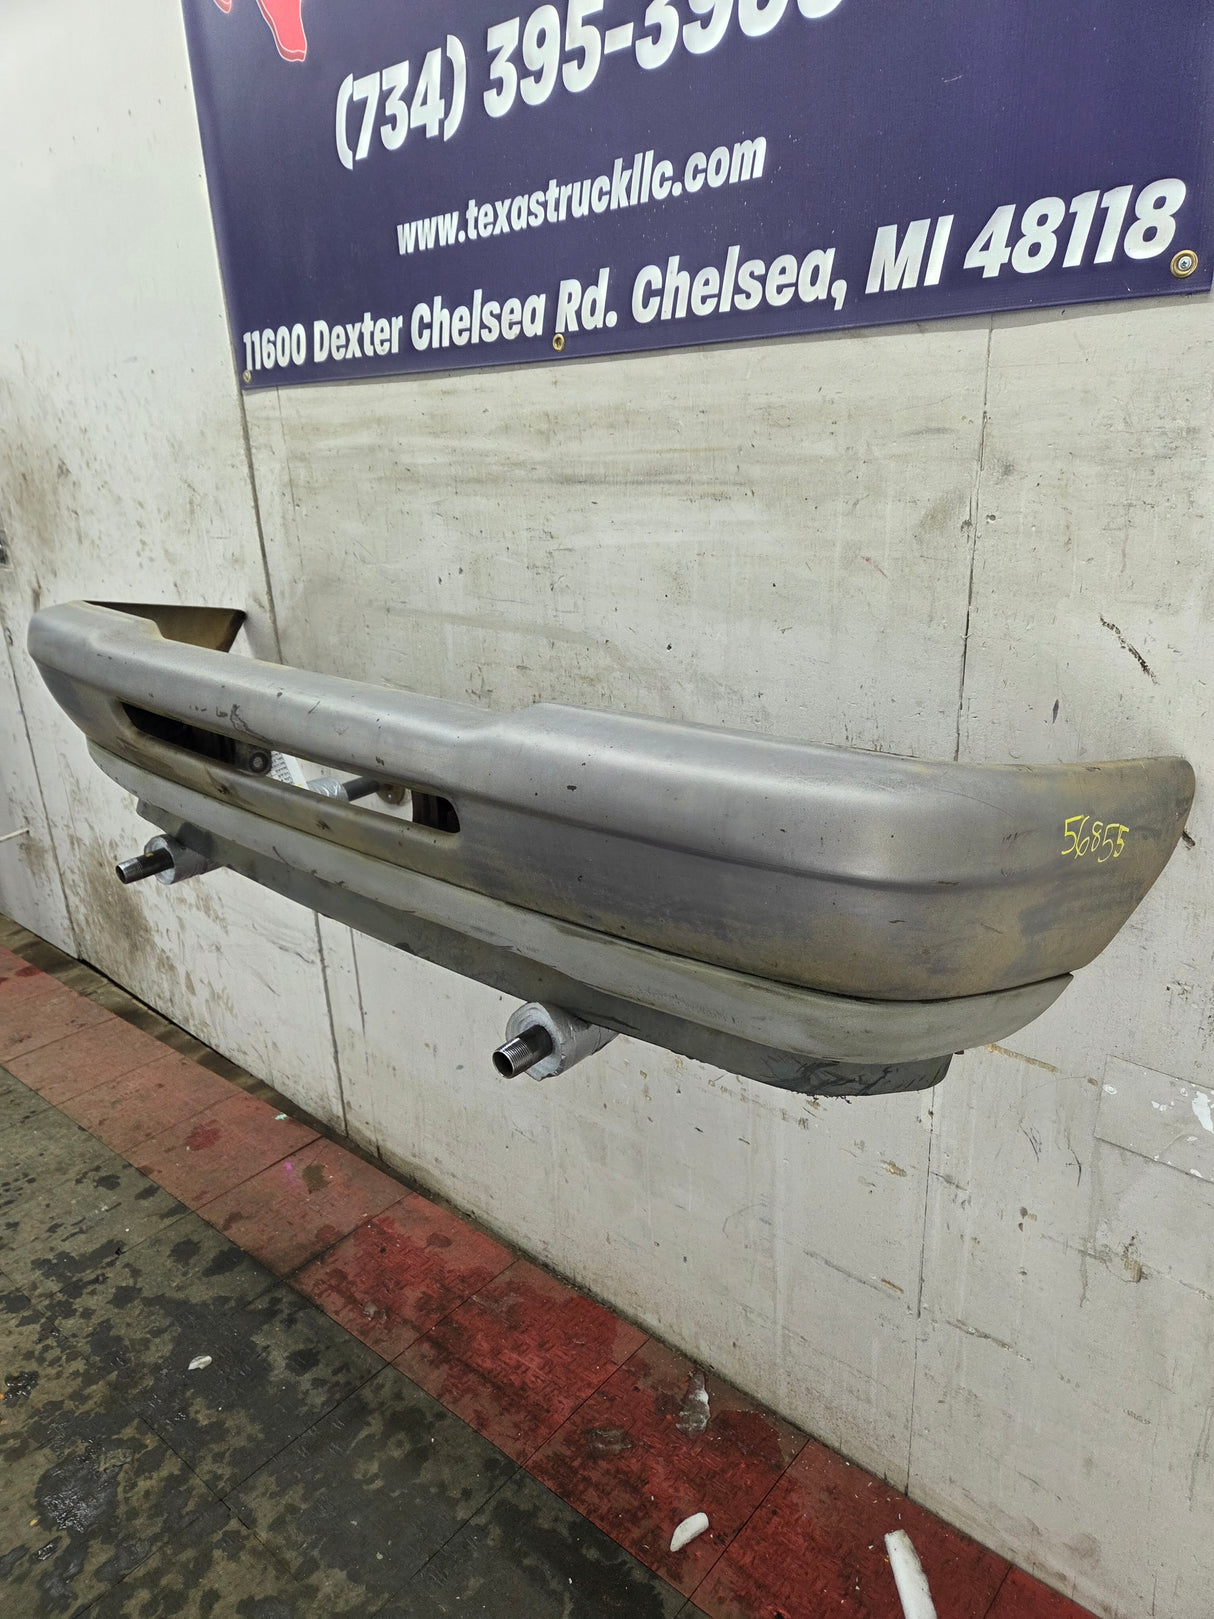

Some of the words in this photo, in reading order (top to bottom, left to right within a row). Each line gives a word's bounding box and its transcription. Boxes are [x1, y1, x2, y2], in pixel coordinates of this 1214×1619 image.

[335, 34, 467, 170] (734)
[483, 0, 843, 118] 395-39
[396, 136, 767, 255] www.texastruckllc.com
[243, 323, 307, 372] 11600
[313, 311, 404, 363] Dexter
[410, 288, 547, 351] Chelsea
[554, 266, 618, 334] Rd.
[631, 244, 848, 324] Chelsea,
[864, 214, 955, 294] MI
[963, 178, 1187, 279] 48118
[1061, 814, 1130, 863] 56855
